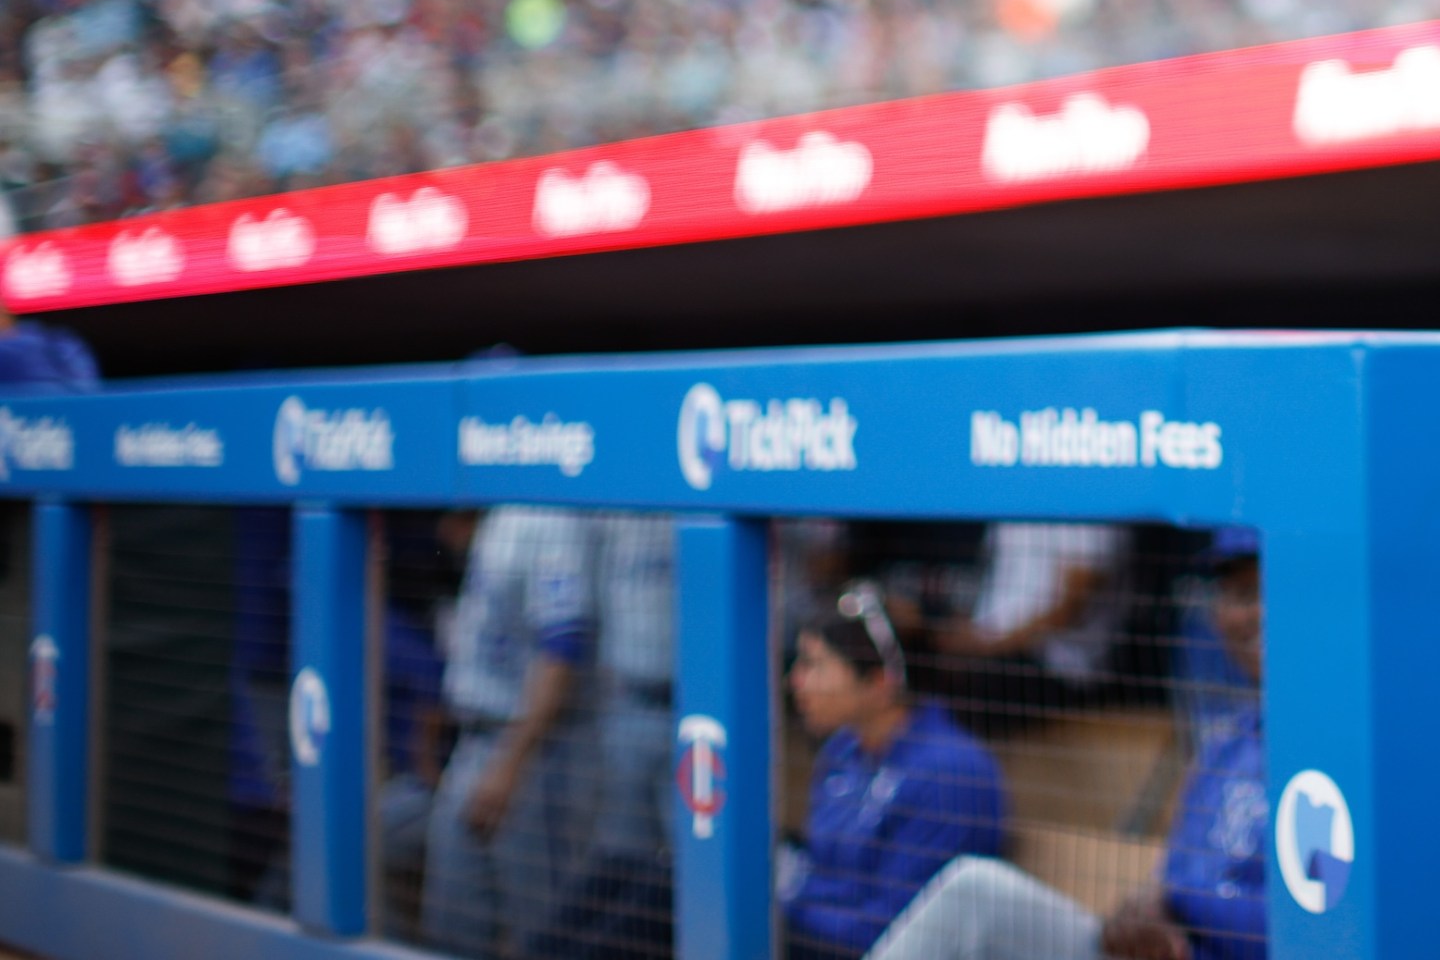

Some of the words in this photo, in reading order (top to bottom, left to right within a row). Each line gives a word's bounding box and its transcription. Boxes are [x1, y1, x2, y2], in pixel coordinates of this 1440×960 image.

[727, 397, 858, 472] TickPick
[970, 410, 1019, 467] No
[1020, 407, 1138, 467] Hidden
[1140, 410, 1223, 469] Fees
